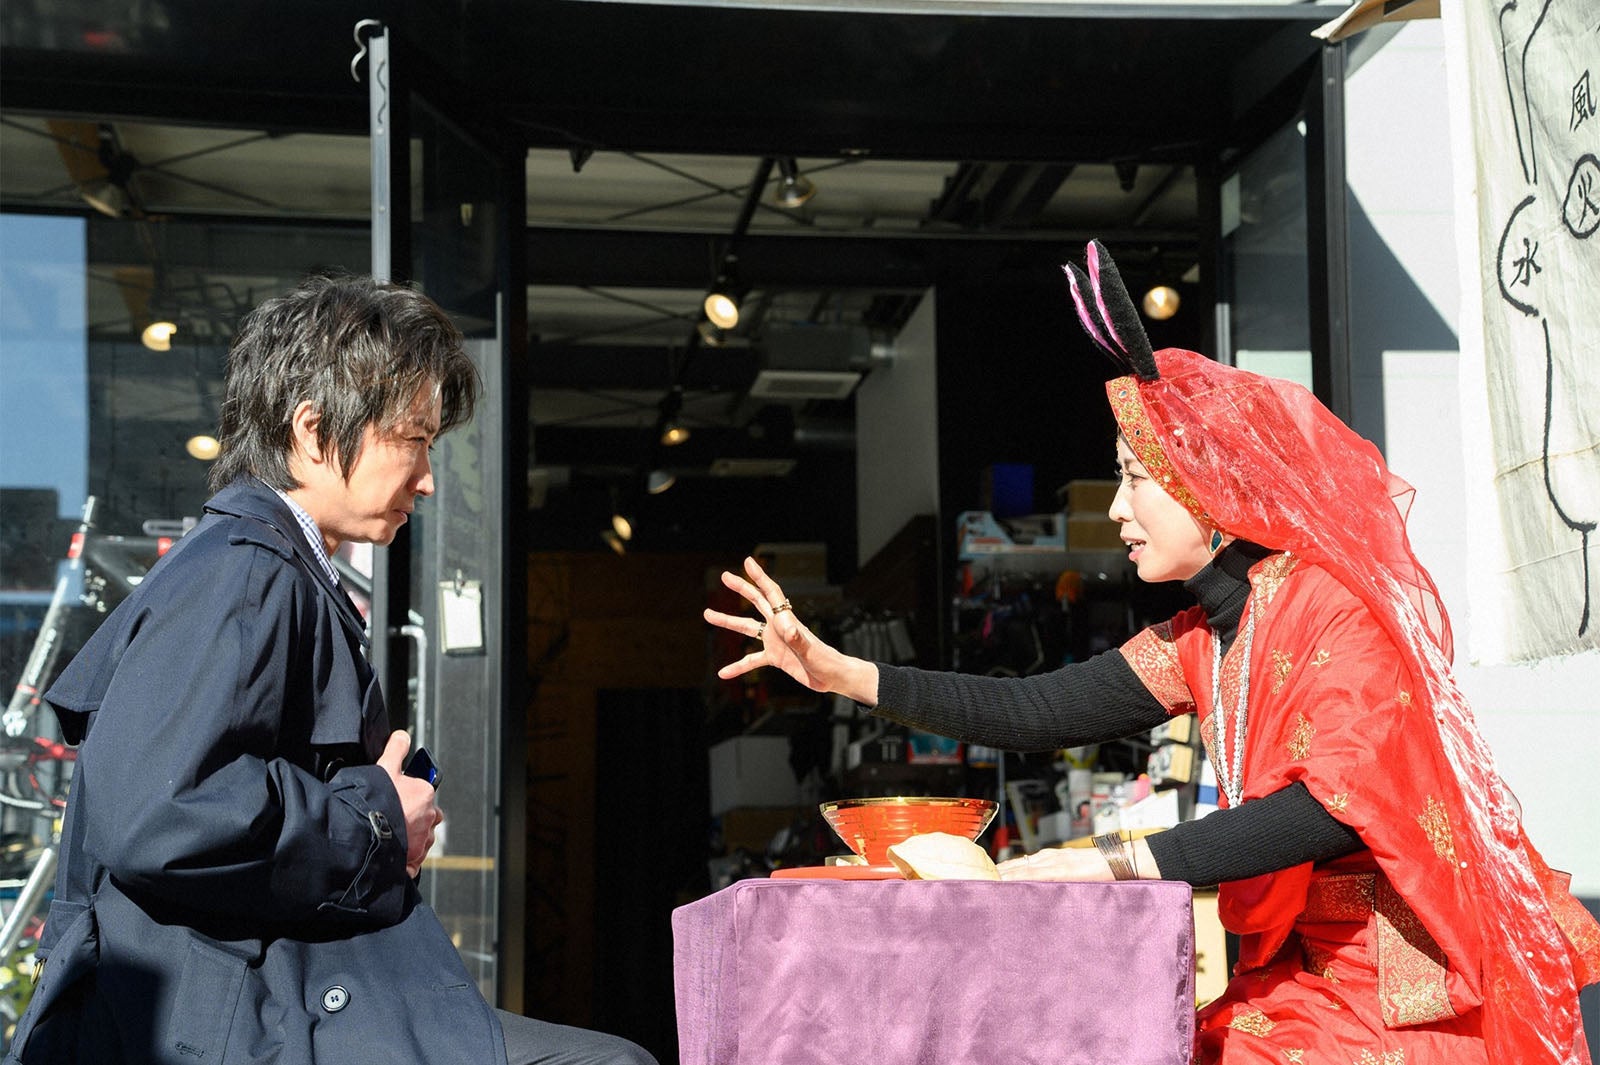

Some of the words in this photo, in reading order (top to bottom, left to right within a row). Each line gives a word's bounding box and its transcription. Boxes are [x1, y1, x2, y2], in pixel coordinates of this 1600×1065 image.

[1569, 68, 1597, 132] 風
[1577, 170, 1599, 228] 火
[1508, 237, 1542, 288] 水
